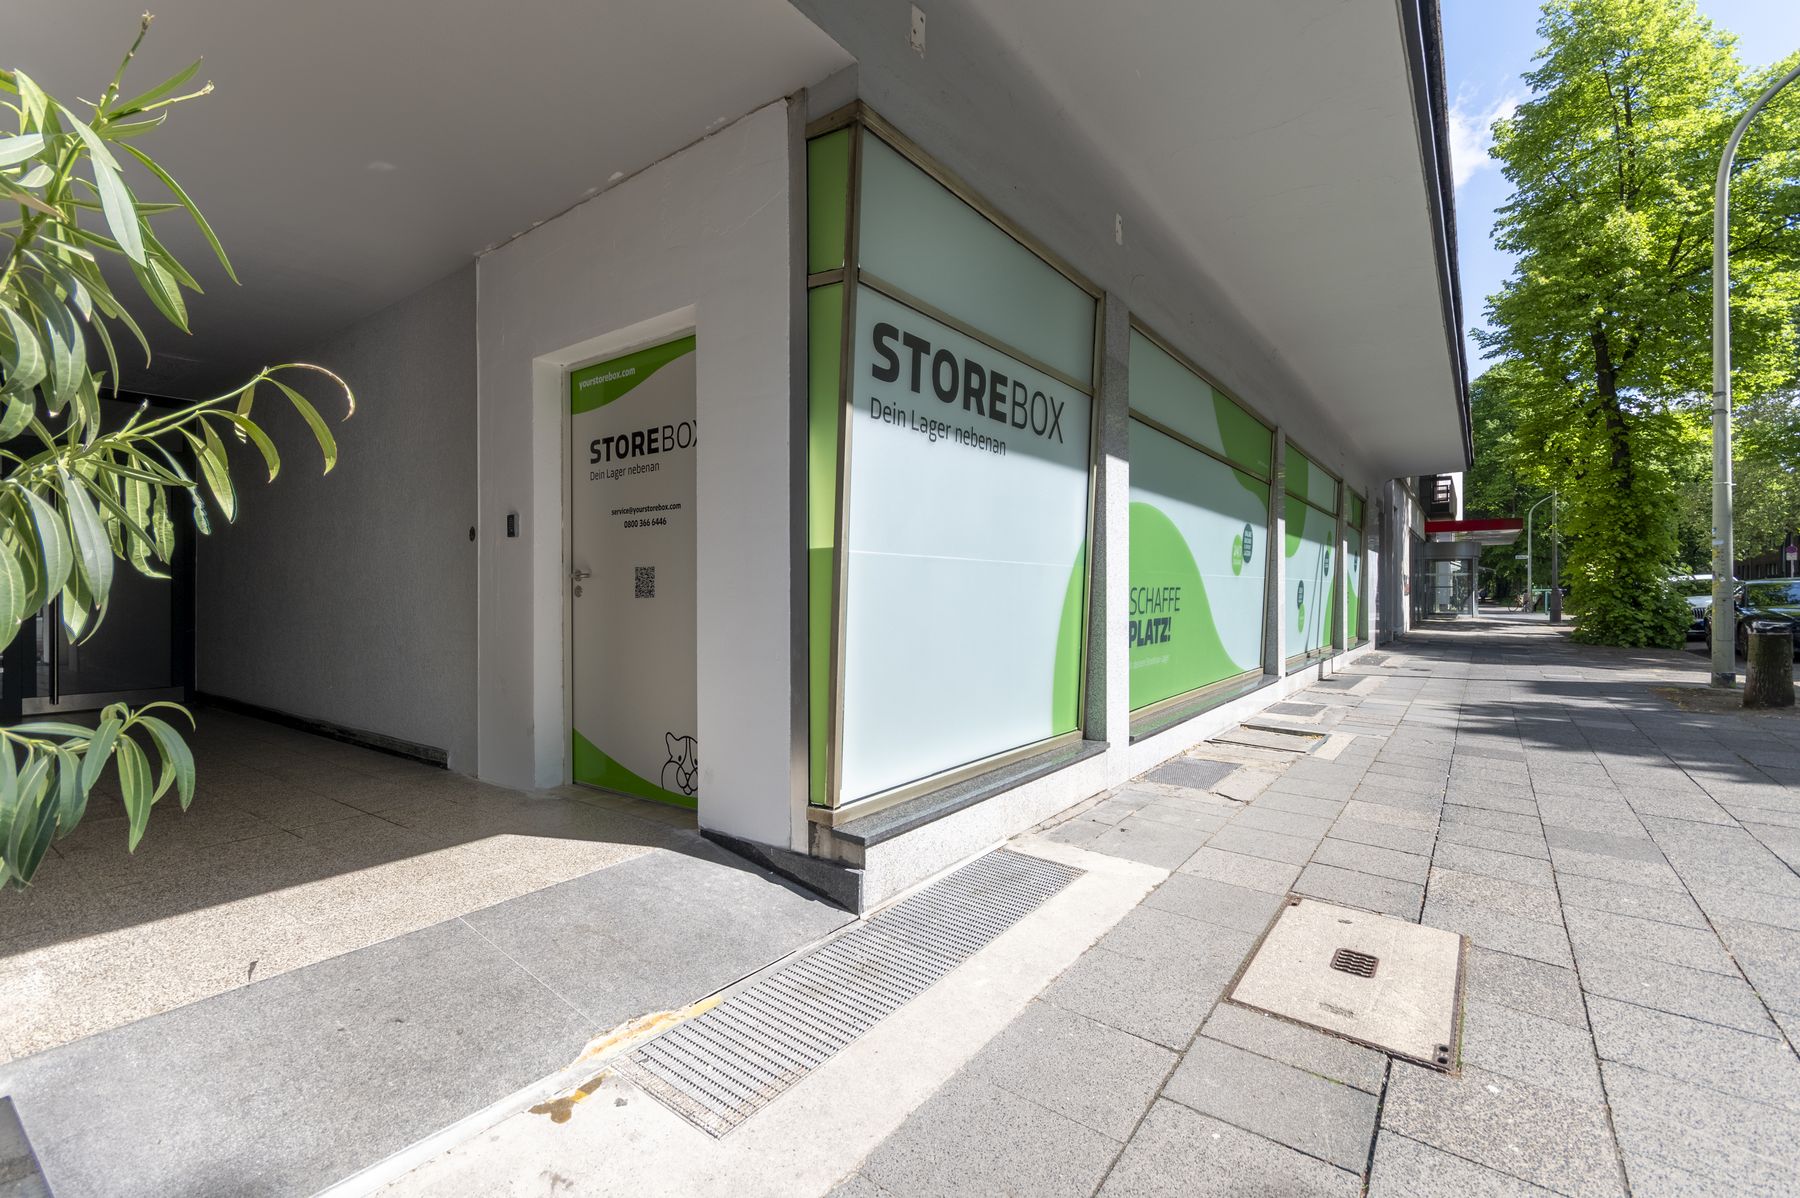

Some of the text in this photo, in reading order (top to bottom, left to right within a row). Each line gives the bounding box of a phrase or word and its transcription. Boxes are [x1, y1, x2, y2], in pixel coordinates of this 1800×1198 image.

[579, 367, 636, 391] yourstorebox.com
[872, 322, 1065, 444] STOREBOX
[870, 396, 1007, 456] Dein Lager nebenan
[590, 462, 660, 481] Dein Lager nebenan
[611, 503, 682, 516] service@yourstorebox.com
[624, 517, 667, 528] 0800 366 6446
[1129, 587, 1181, 616] SCHAFFE
[1129, 617, 1172, 649] PLATZ!
